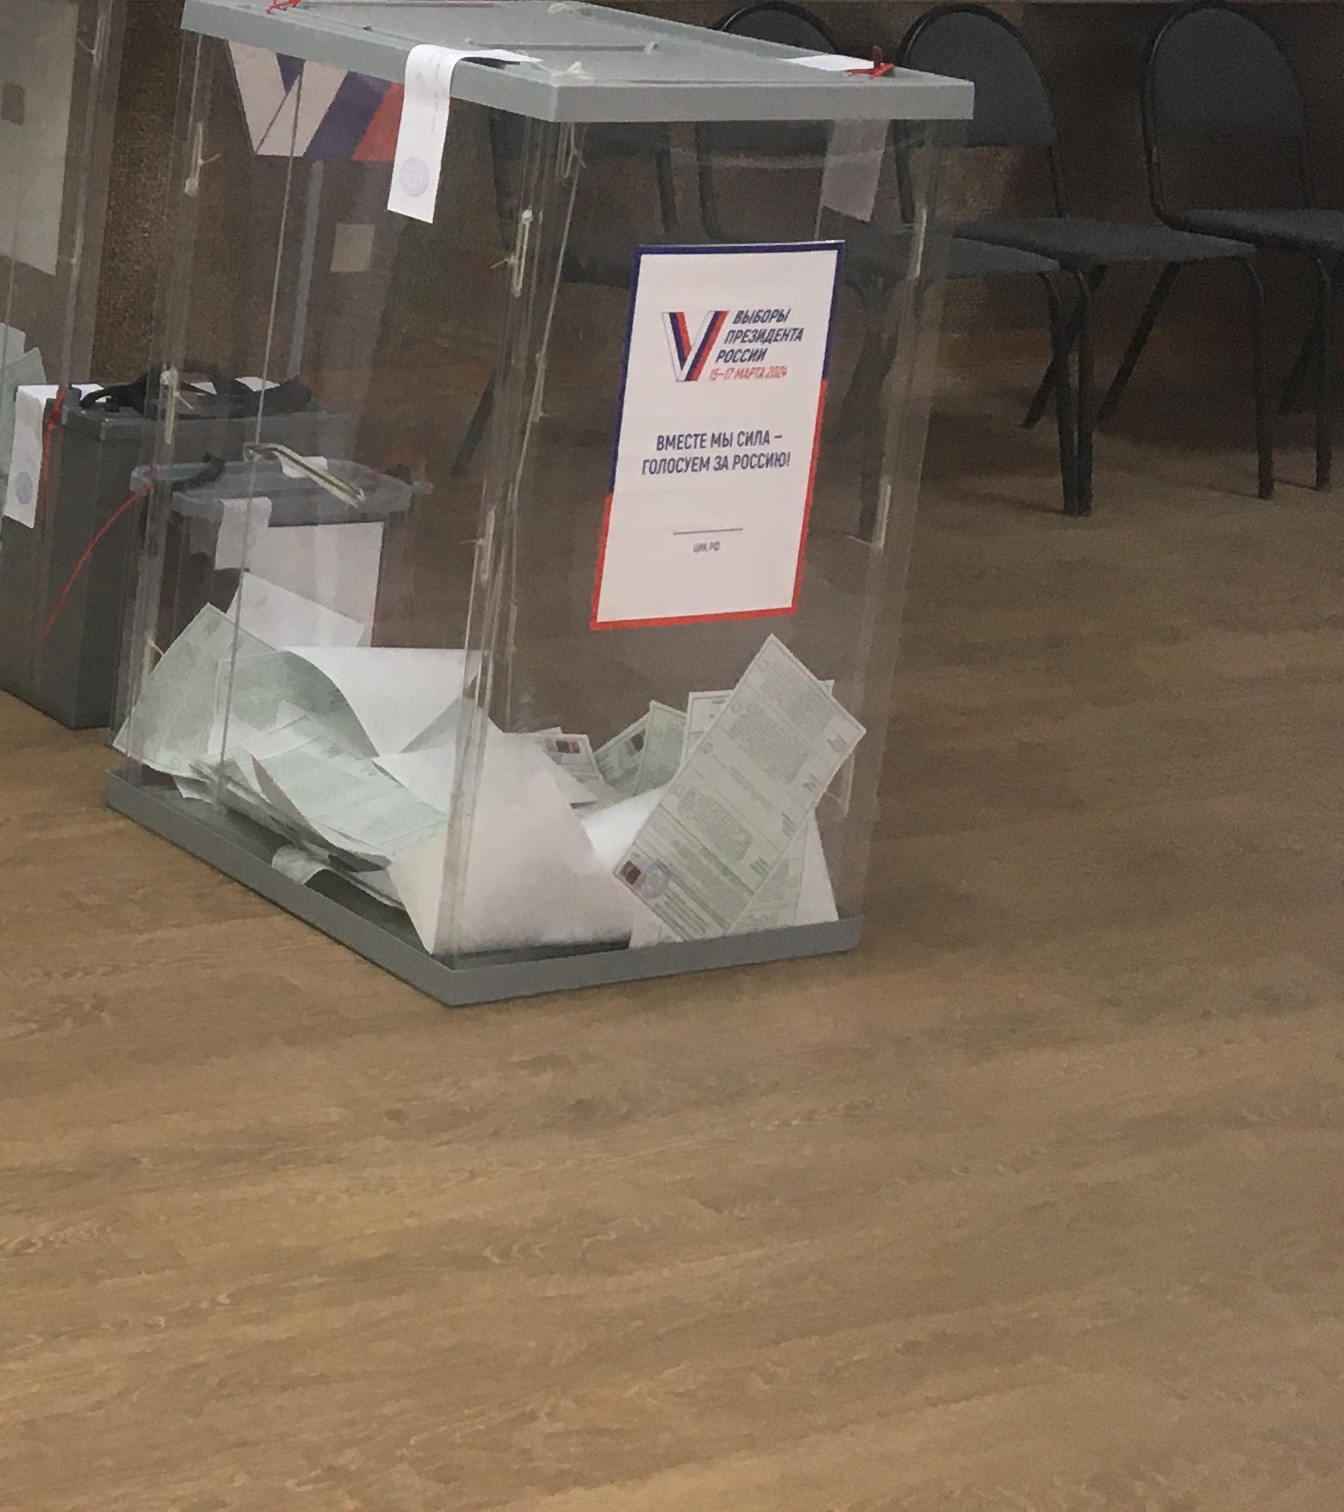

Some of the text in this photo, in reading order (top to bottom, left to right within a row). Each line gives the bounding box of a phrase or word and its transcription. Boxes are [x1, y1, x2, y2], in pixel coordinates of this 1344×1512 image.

[732, 308, 791, 324] ВЫБОРЫ
[724, 327, 804, 345] ПРЕЗИДЕНТА
[715, 348, 768, 363] РОССИИ
[734, 366, 765, 380] МАРТА
[656, 433, 707, 451] ВМЕСТЕ
[710, 431, 733, 448] МЫ
[736, 430, 770, 447] СИЛА
[641, 451, 791, 475] ГОЛОСУЕМ ЗА РОССИЮ!
